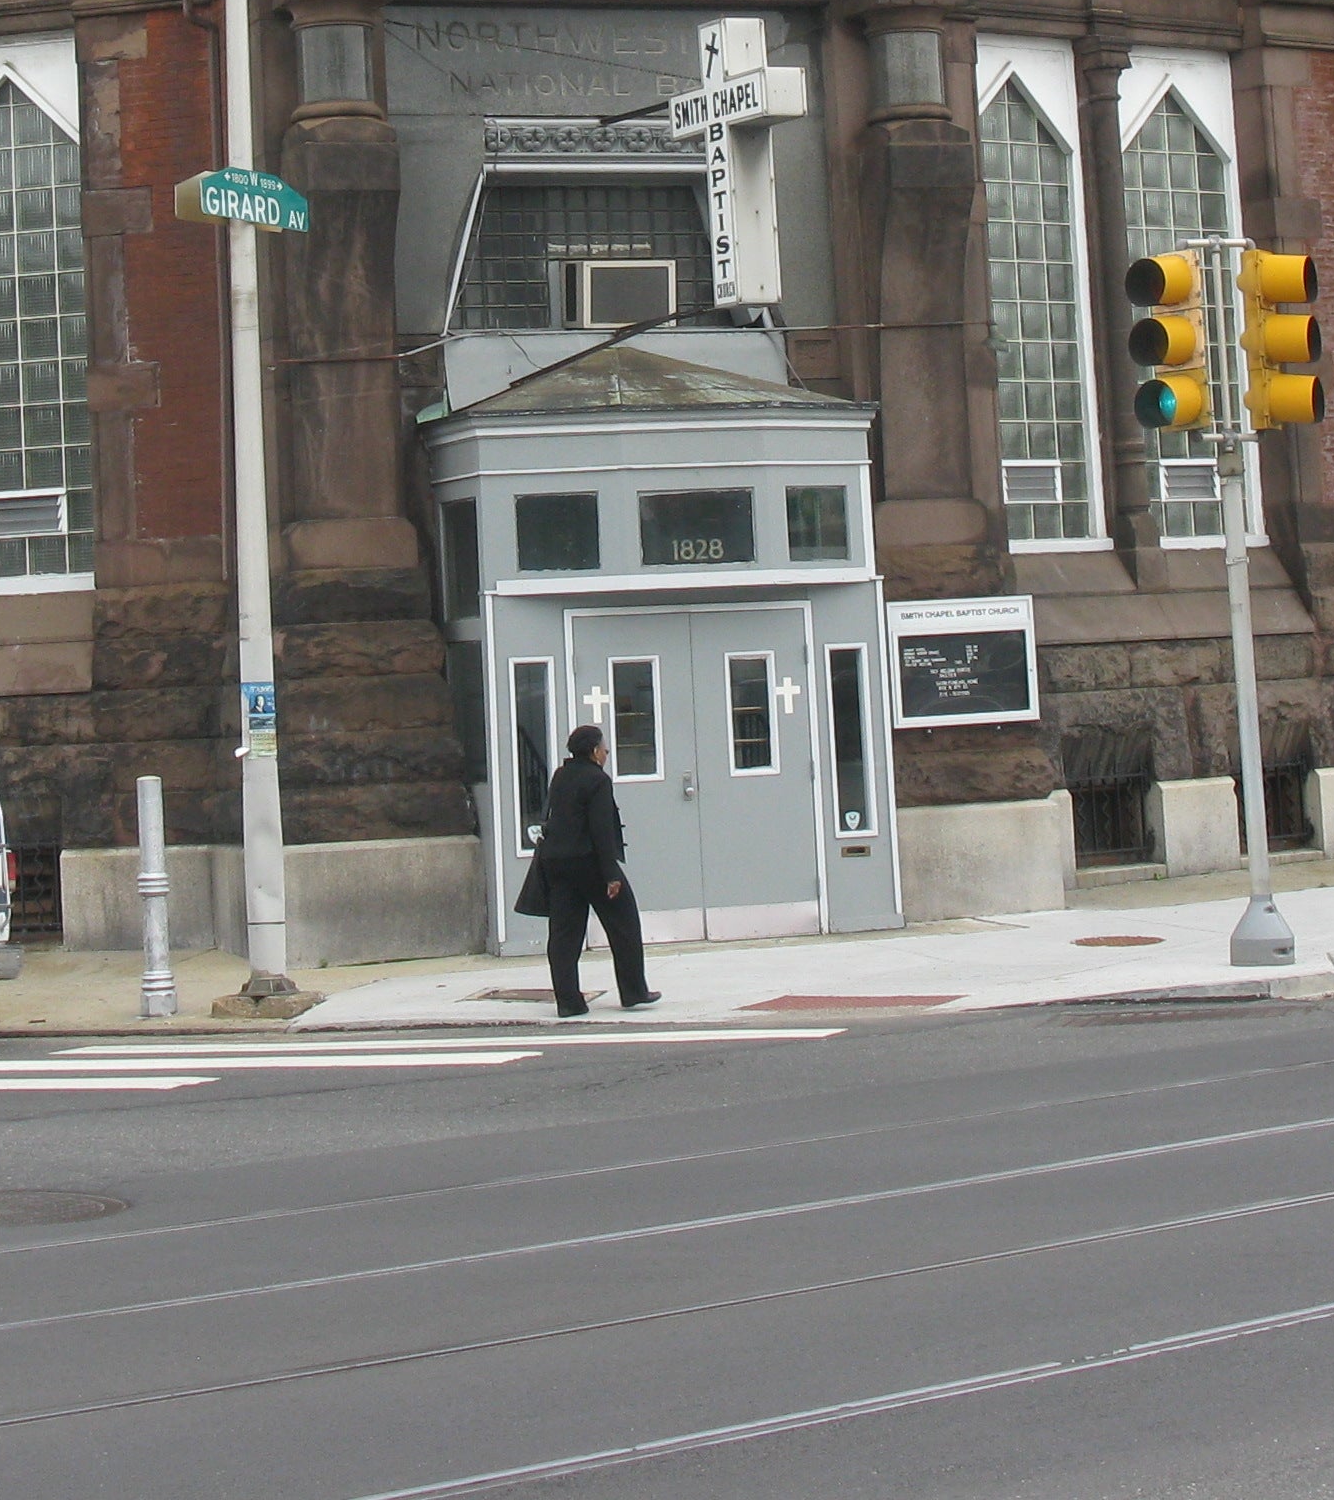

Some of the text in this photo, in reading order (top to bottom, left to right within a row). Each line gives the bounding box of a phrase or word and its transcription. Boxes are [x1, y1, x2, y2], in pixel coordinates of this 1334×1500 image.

[416, 20, 701, 55] NORTHWEST
[450, 69, 701, 97] NATIONAL BA
[674, 80, 759, 130] SMITH CHAPEL
[249, 171, 259, 187] W
[205, 186, 306, 230] GIRARD AV
[709, 122, 732, 280] BAPTIST
[671, 538, 725, 563] 1828
[900, 606, 1020, 620] SMITH CHAPEL BAPTIST CHURCH
